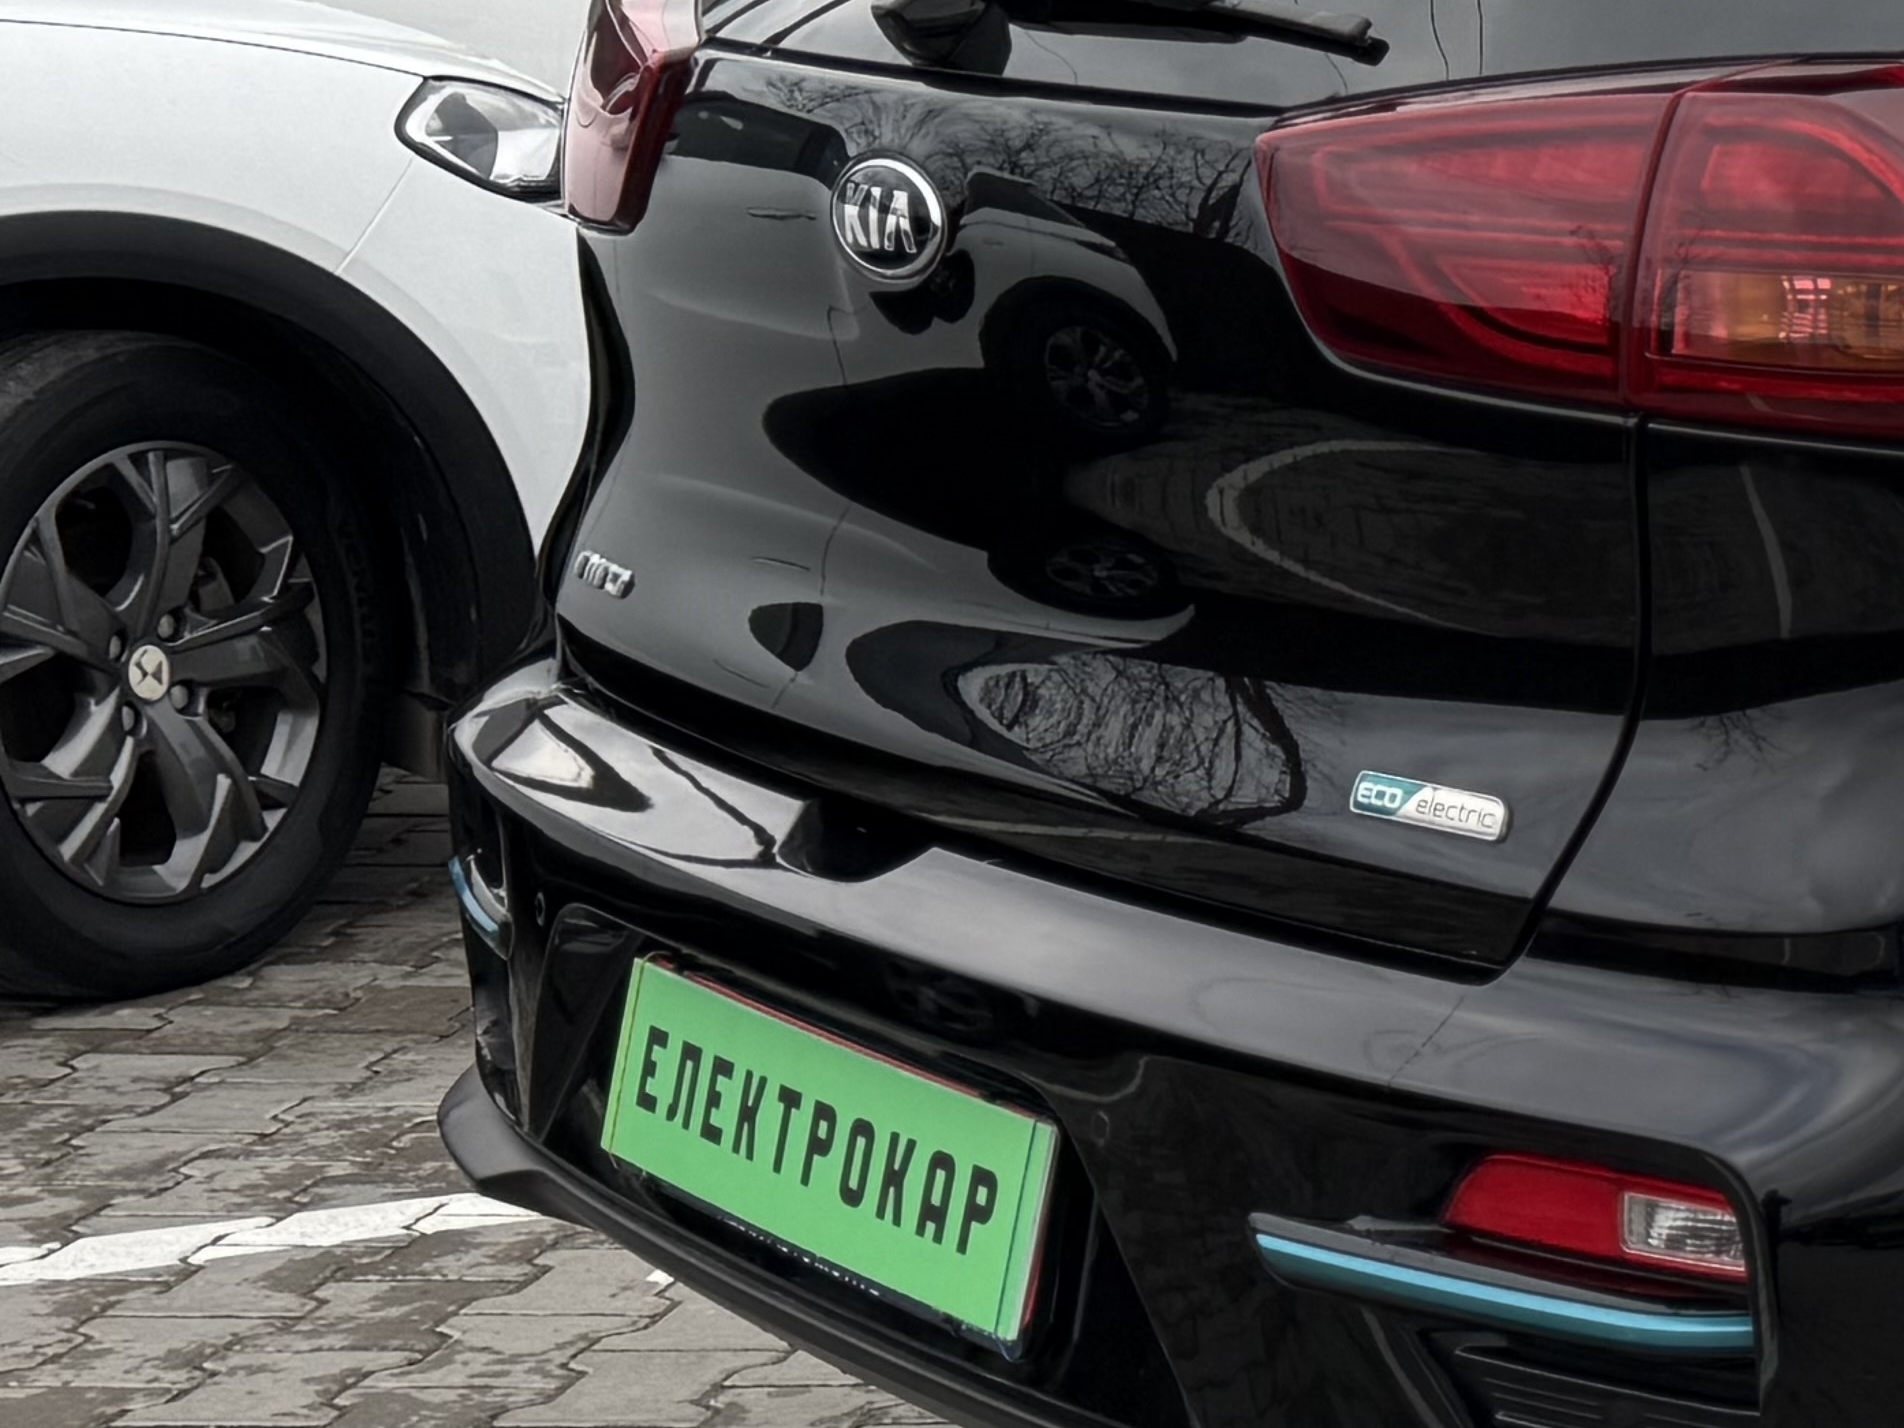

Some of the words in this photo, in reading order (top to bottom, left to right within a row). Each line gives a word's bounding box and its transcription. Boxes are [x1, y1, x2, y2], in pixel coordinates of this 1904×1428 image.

[844, 182, 917, 253] KIA
[1356, 781, 1403, 809] ECO
[1415, 791, 1497, 828] electric
[634, 1024, 999, 1257] ЕЛЕКТРОКАР
